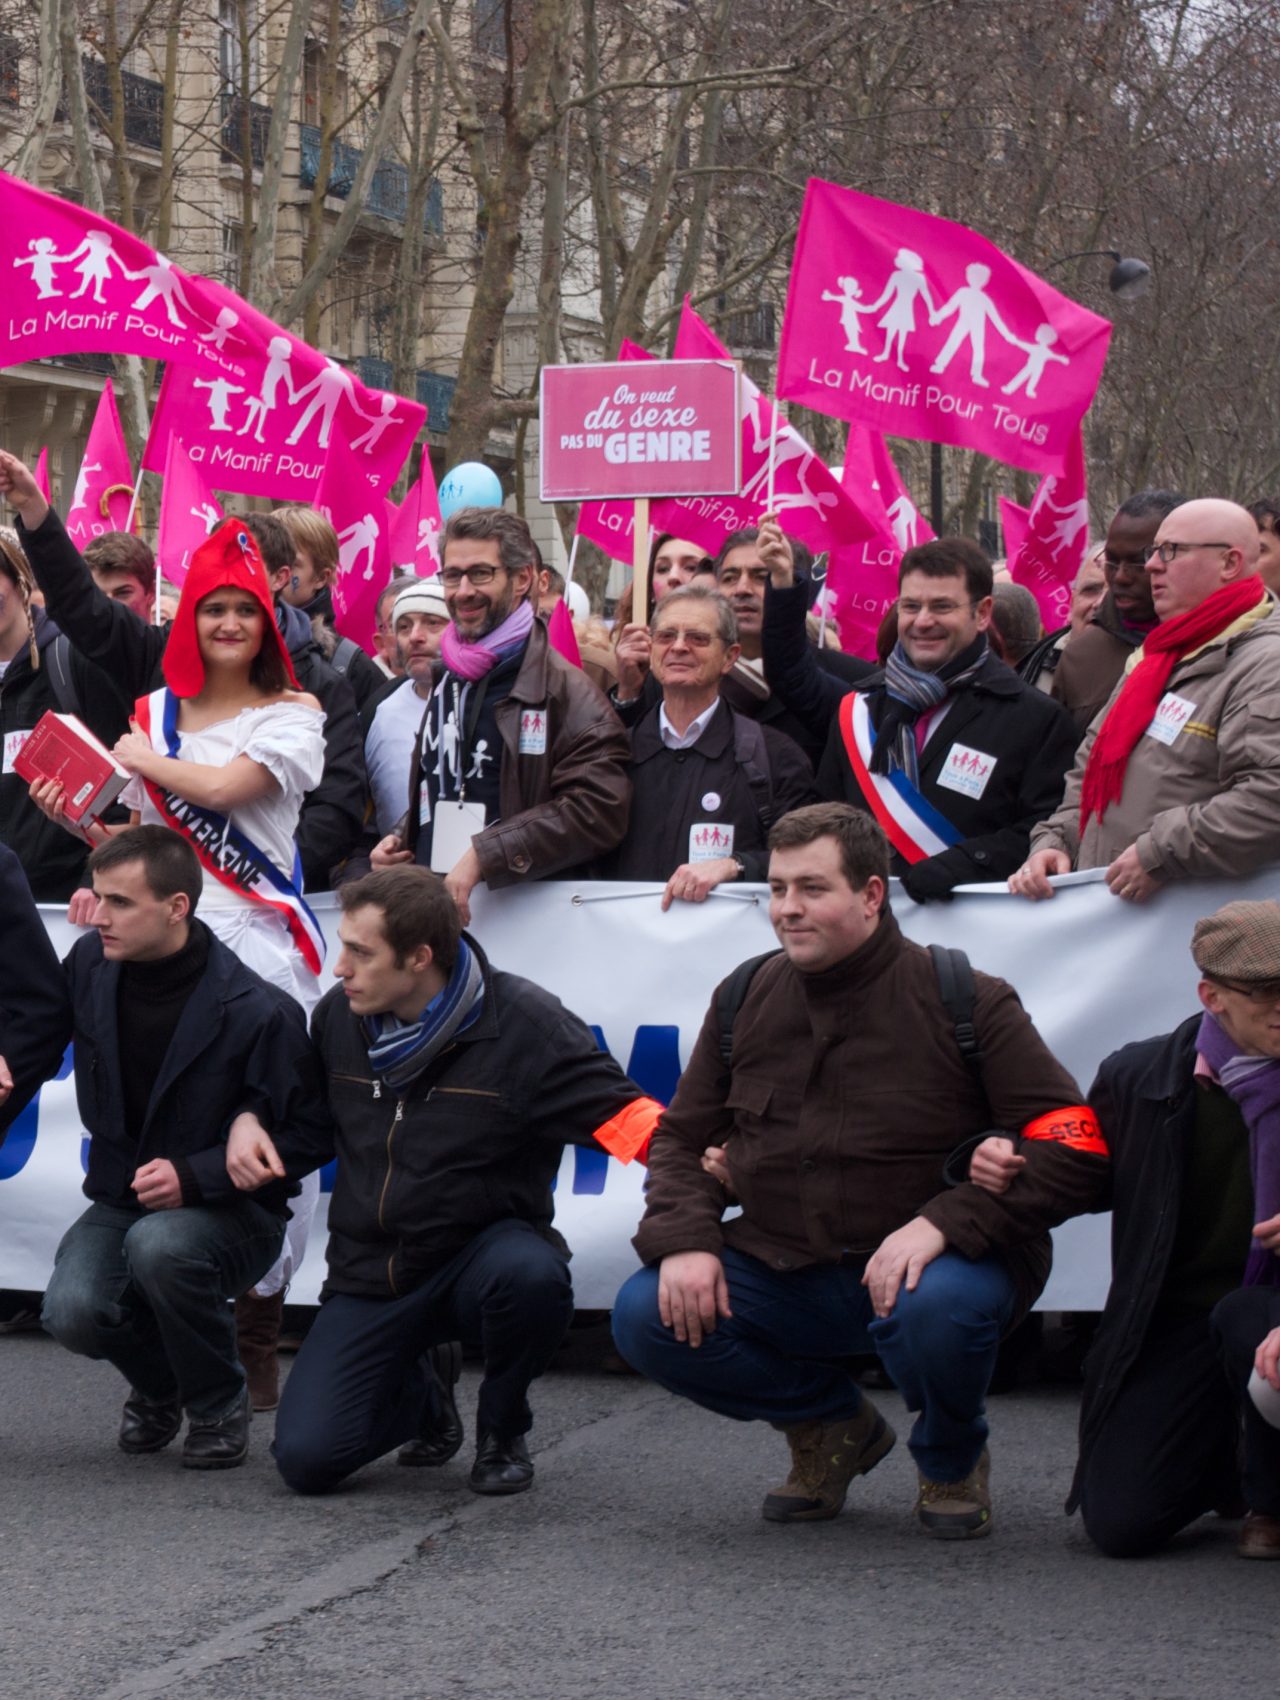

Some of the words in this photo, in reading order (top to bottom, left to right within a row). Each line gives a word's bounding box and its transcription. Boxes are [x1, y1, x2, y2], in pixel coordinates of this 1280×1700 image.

[9, 318, 37, 341] La
[44, 311, 119, 333] Manif
[124, 318, 186, 347] Pour
[192, 337, 247, 377] Tous
[612, 384, 637, 405] On
[639, 385, 676, 404] veut
[808, 358, 842, 388] La
[849, 369, 920, 408] Manif
[925, 386, 984, 421] Pour
[991, 403, 1050, 446] Tous
[583, 397, 625, 431] du
[629, 405, 698, 428] sexe
[178, 436, 206, 461] a
[210, 447, 273, 476] Manif
[277, 456, 325, 481] Pour
[560, 434, 584, 450] PAS
[586, 433, 603, 449] DU
[604, 430, 711, 464] GENRE
[597, 502, 623, 532] La
[861, 541, 896, 566] La
[851, 592, 878, 613] La
